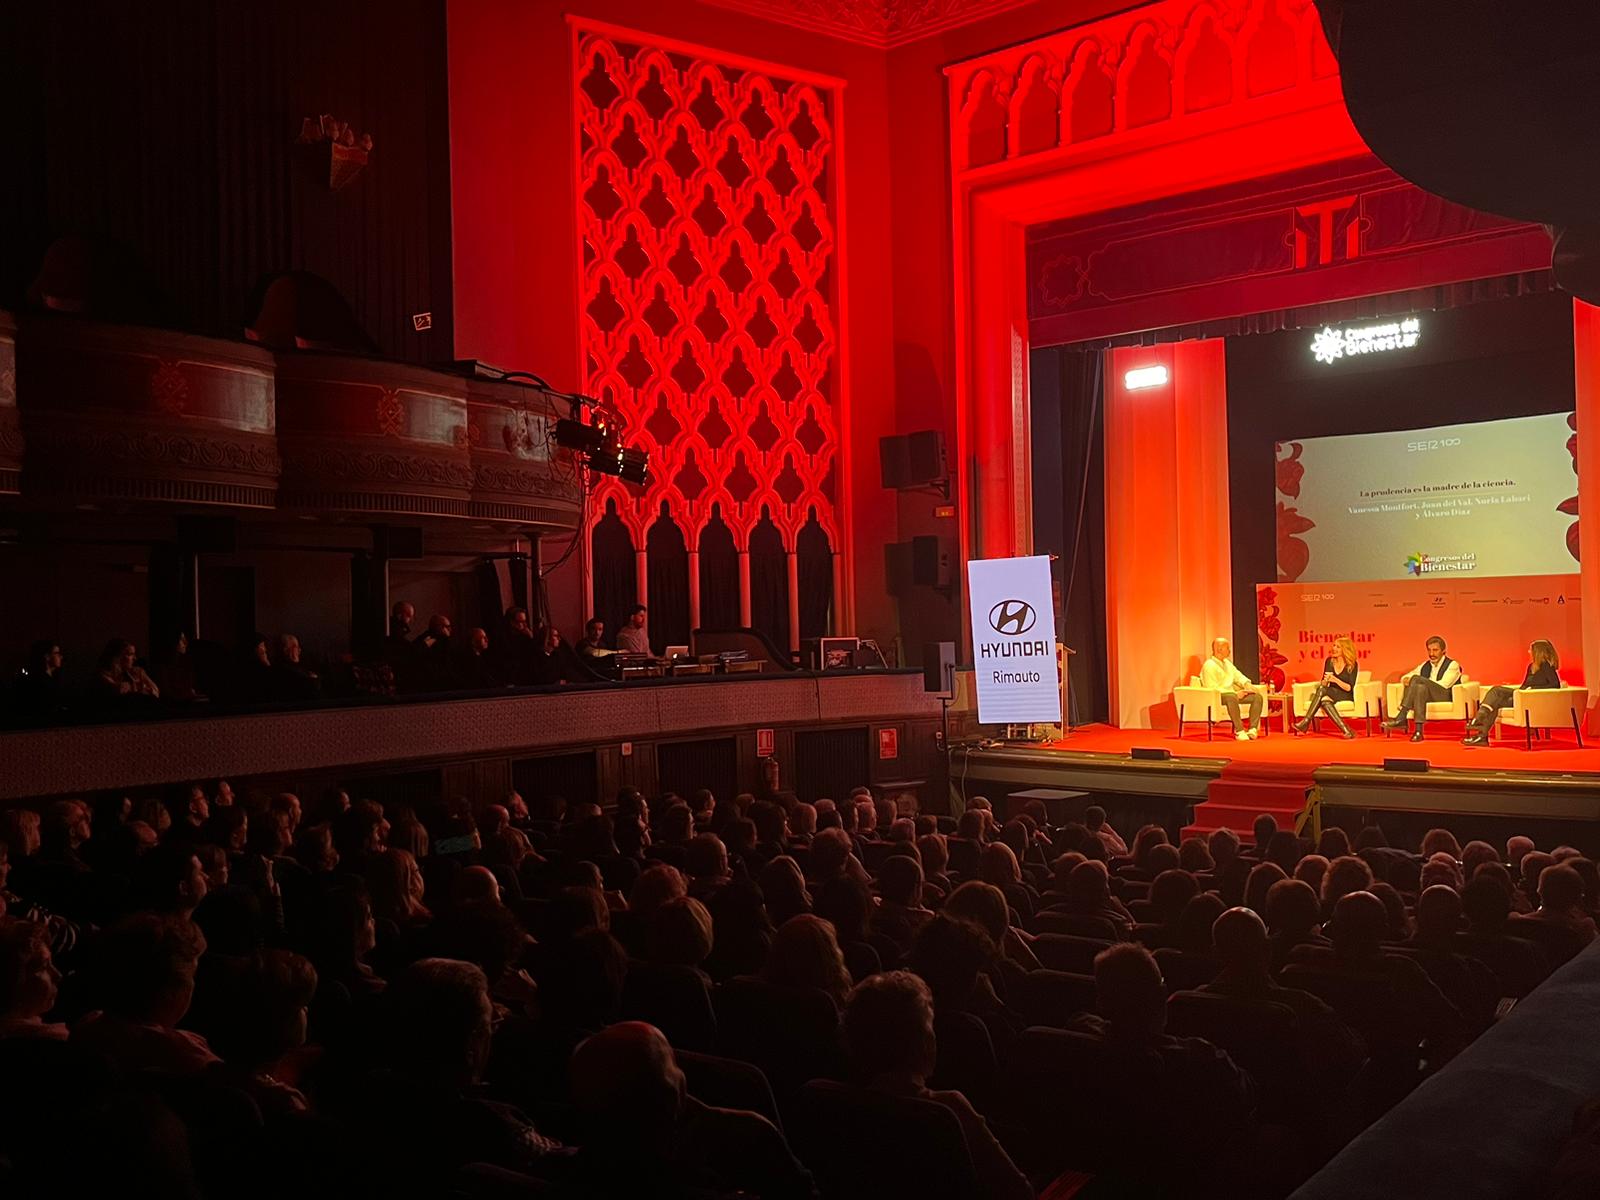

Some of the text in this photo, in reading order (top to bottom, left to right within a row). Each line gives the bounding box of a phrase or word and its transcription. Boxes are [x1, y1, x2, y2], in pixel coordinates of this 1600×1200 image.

[1345, 333, 1420, 356] Bienestar
[1360, 490, 1370, 498] La
[1371, 487, 1412, 498] prudencia
[1432, 483, 1460, 491] madre
[1461, 481, 1472, 489] de
[1482, 478, 1516, 487] ciencia.
[1348, 506, 1380, 514] Vanessa
[1442, 499, 1456, 507] del
[1420, 554, 1461, 563] Congresos
[1420, 562, 1476, 572] Bienestar
[980, 640, 1049, 659] HYUNDAI
[1298, 650, 1305, 663] y
[1310, 645, 1324, 659] el
[993, 670, 1040, 684] Rimauto
